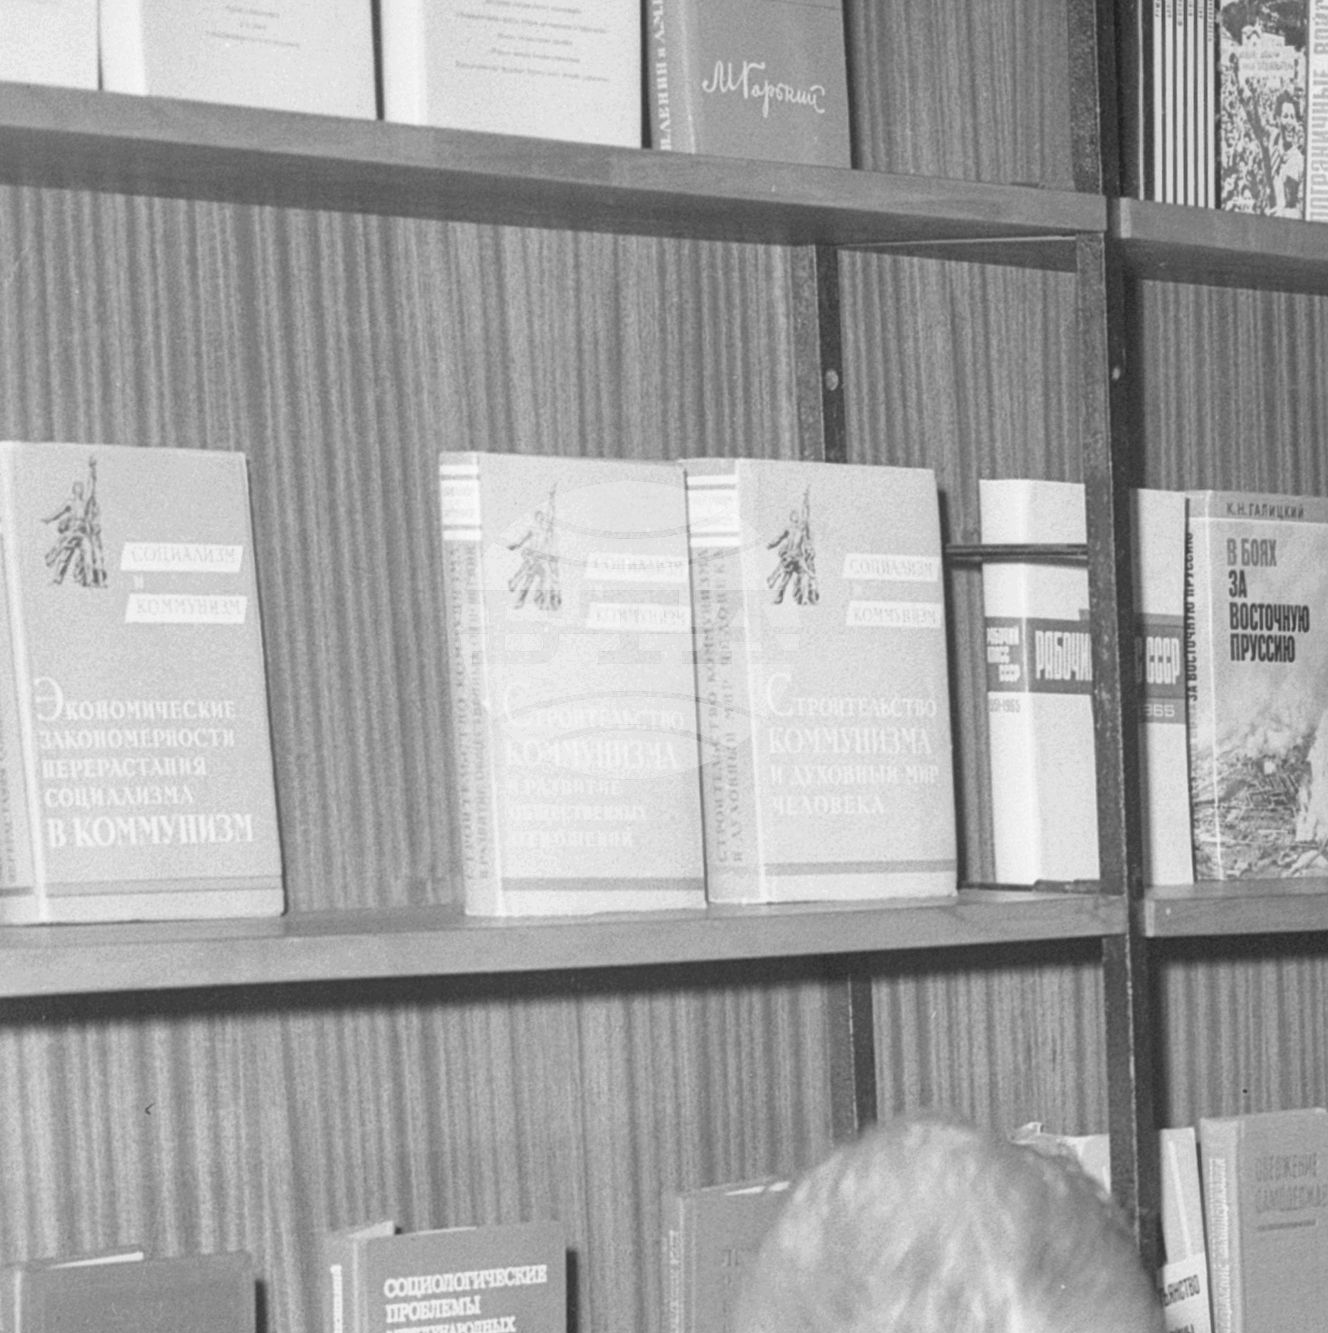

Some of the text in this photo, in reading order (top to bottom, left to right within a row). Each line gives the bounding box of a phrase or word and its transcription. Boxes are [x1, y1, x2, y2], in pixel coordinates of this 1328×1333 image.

[1226, 538, 1277, 567] В БОЯХ
[1228, 570, 1247, 598] ЗА
[1229, 602, 1310, 633] ВОСТОЧНУЮ
[1035, 630, 1093, 681] РАБОЧИ
[1146, 636, 1181, 685] СССР
[1230, 633, 1296, 663] ПРУССИЮ
[39, 727, 235, 750] ЗАКОНОМЕРНОСТИ
[768, 726, 932, 755] КОММУНИЗМА
[42, 757, 208, 779] ПЕРЕРАСТАНИЯ
[44, 785, 195, 810] СОЦИАЛИЗМА
[47, 813, 254, 848] В КОММУНИЗМ
[384, 1264, 548, 1299] СОЦИОЛОГИЧЕСКИЕ
[385, 1294, 482, 1323] ПРОБЛЕМЫ
